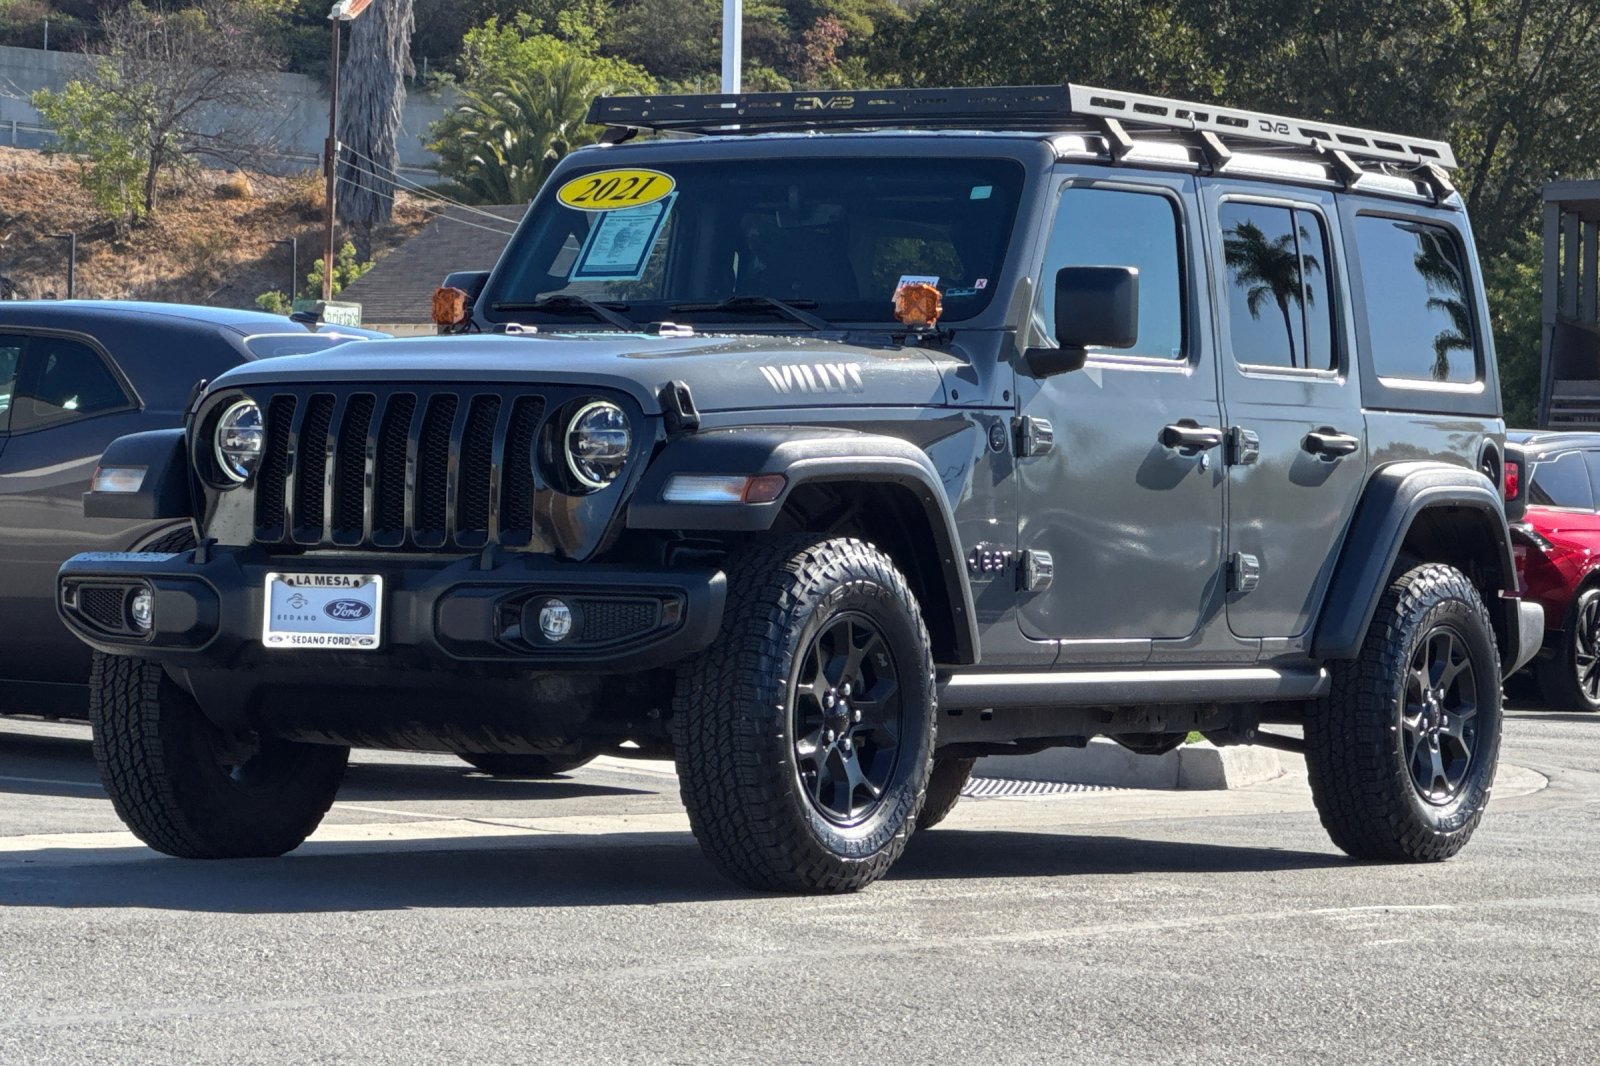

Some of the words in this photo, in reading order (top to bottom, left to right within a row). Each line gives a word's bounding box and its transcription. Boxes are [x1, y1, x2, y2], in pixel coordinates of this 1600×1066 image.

[571, 175, 658, 202] 2021
[758, 363, 864, 394] WILLYS
[969, 543, 1011, 575] Jeep
[296, 575, 311, 585] LA
[314, 576, 350, 586] MESA
[292, 635, 325, 644] SEDANO
[327, 636, 351, 645] FORD
